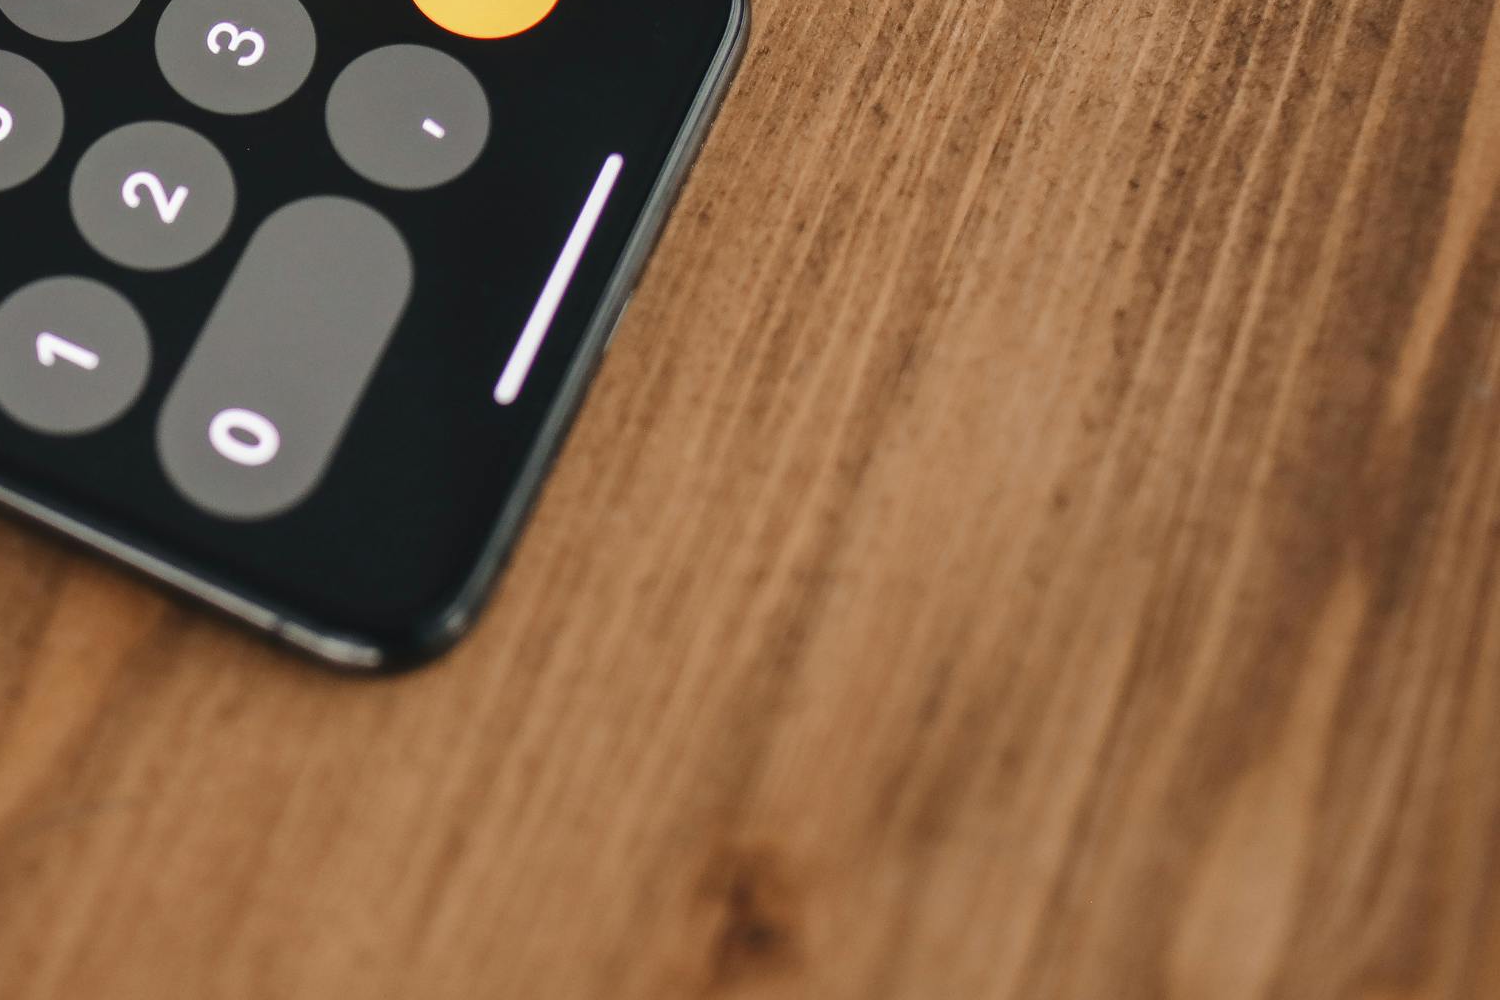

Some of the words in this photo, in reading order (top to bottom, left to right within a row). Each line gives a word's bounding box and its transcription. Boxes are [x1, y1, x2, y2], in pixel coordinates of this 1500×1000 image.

[206, 22, 265, 67] 3
[122, 171, 189, 224] 2
[36, 333, 99, 370] 1
[209, 409, 278, 465] 0
